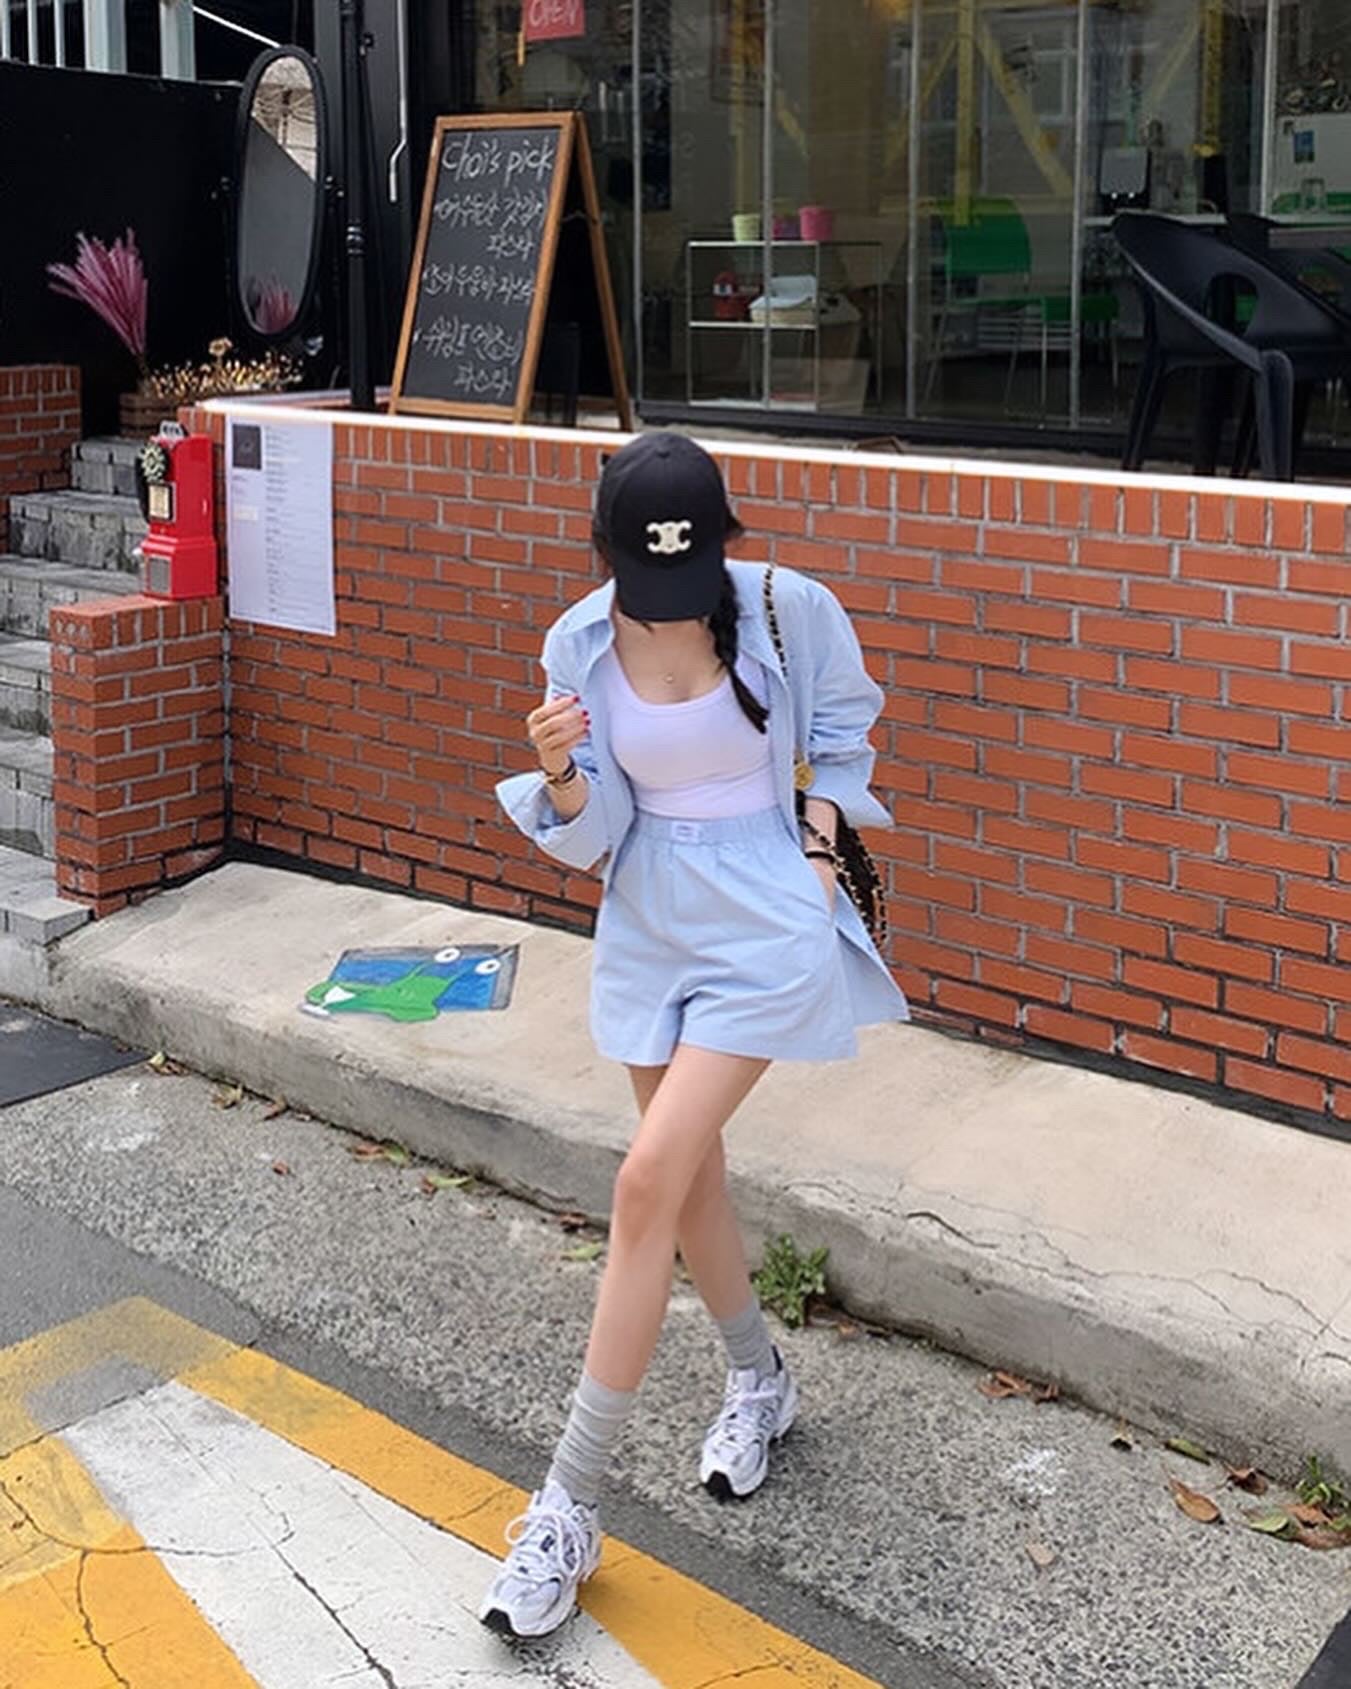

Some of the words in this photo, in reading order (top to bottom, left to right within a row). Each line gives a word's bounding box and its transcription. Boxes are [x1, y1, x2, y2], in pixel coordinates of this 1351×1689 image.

[441, 132, 502, 182] Choi's
[504, 136, 554, 188] pick
[486, 227, 535, 262] 파스타
[453, 361, 513, 399] 파스타
